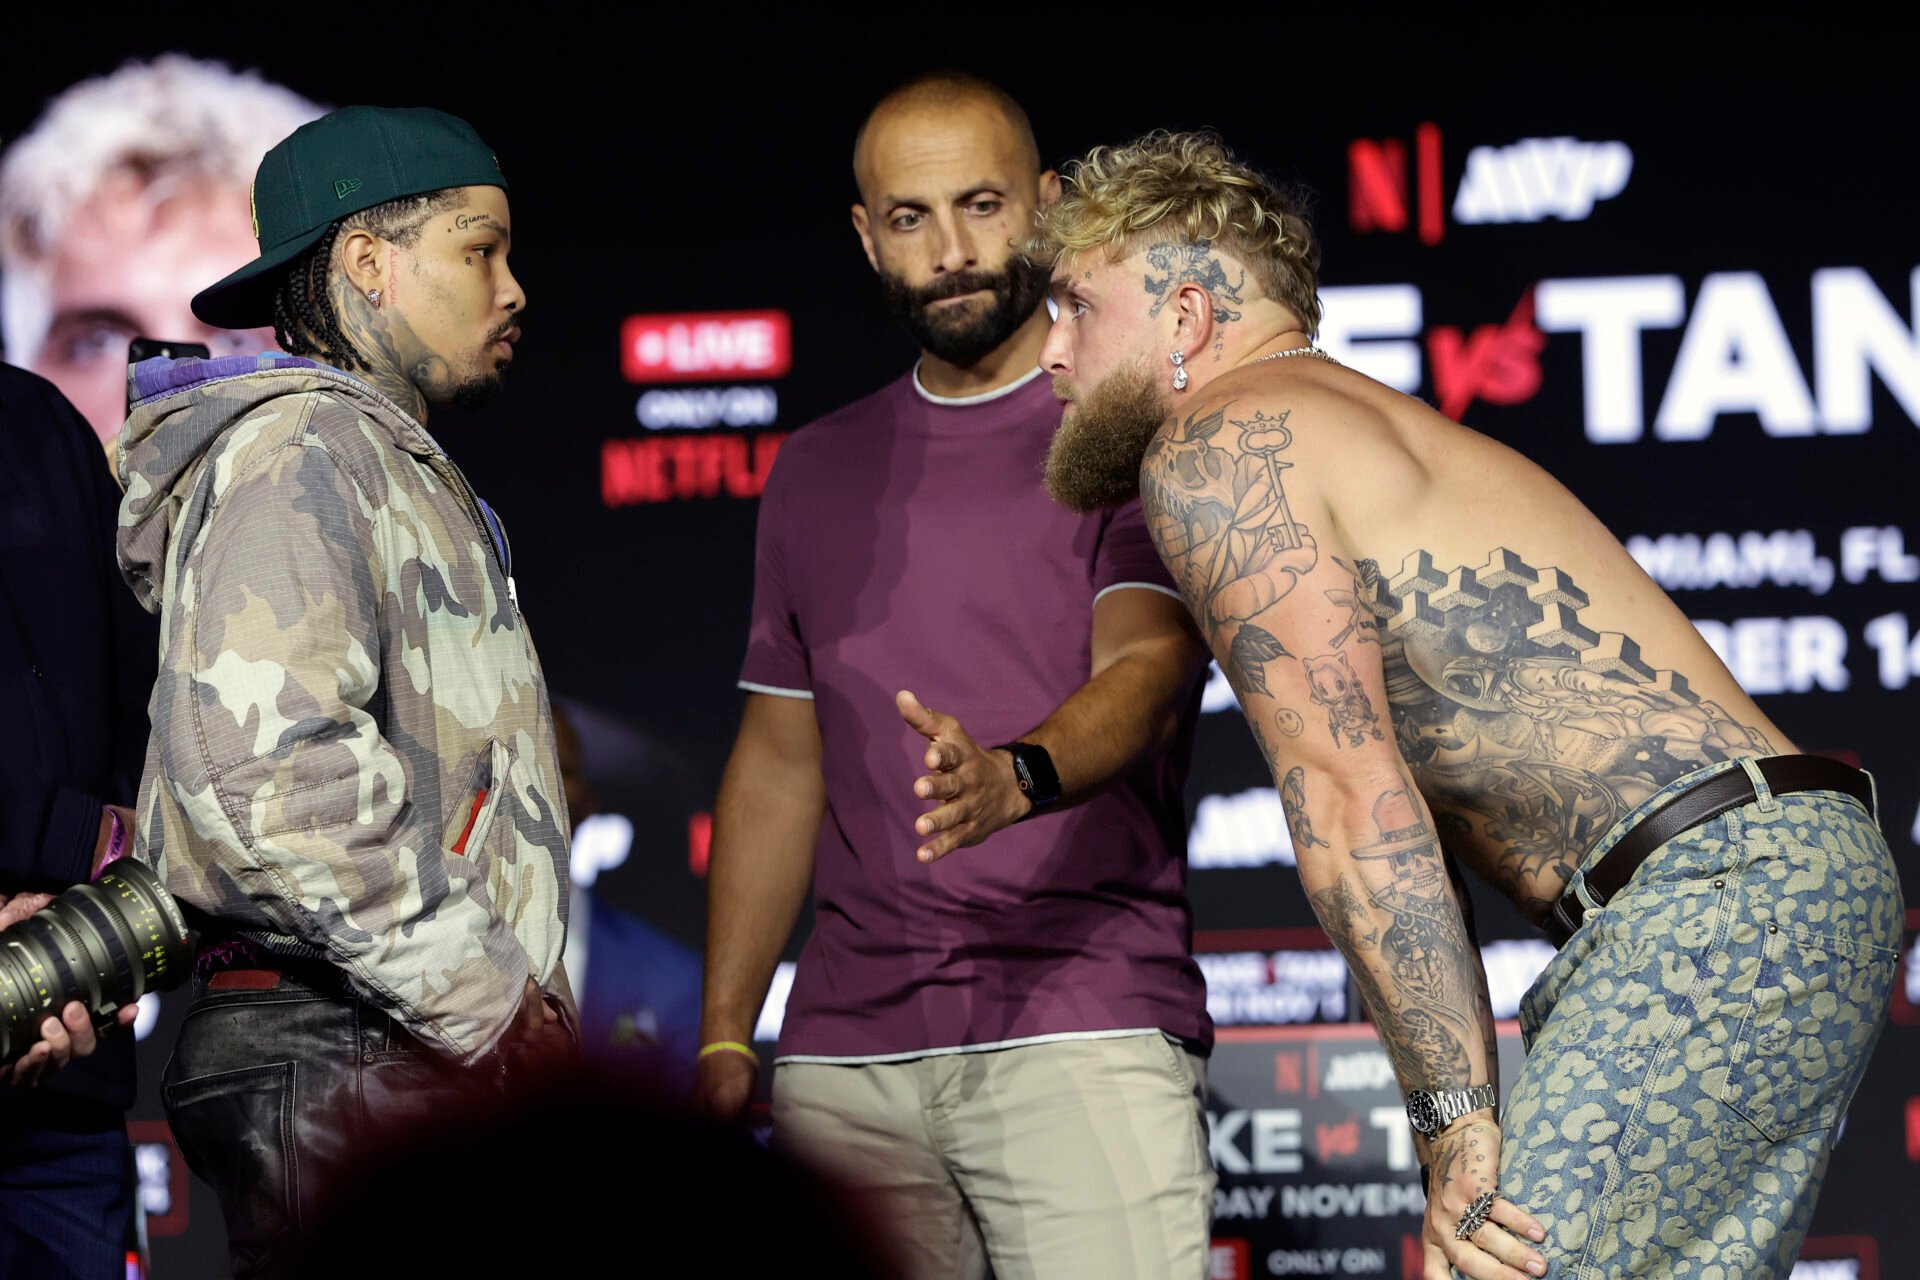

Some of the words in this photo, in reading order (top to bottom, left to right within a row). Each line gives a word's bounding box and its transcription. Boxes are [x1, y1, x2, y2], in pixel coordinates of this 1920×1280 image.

[1534, 266, 1920, 443] TAN
[602, 434, 788, 508] NETFLI
[1207, 1108, 1303, 1175] KE
[1213, 1184, 1275, 1218] DAY
[1281, 1183, 1428, 1218] NOVEM
[1268, 1249, 1340, 1275] ONLY
[1342, 1247, 1386, 1273] ON
